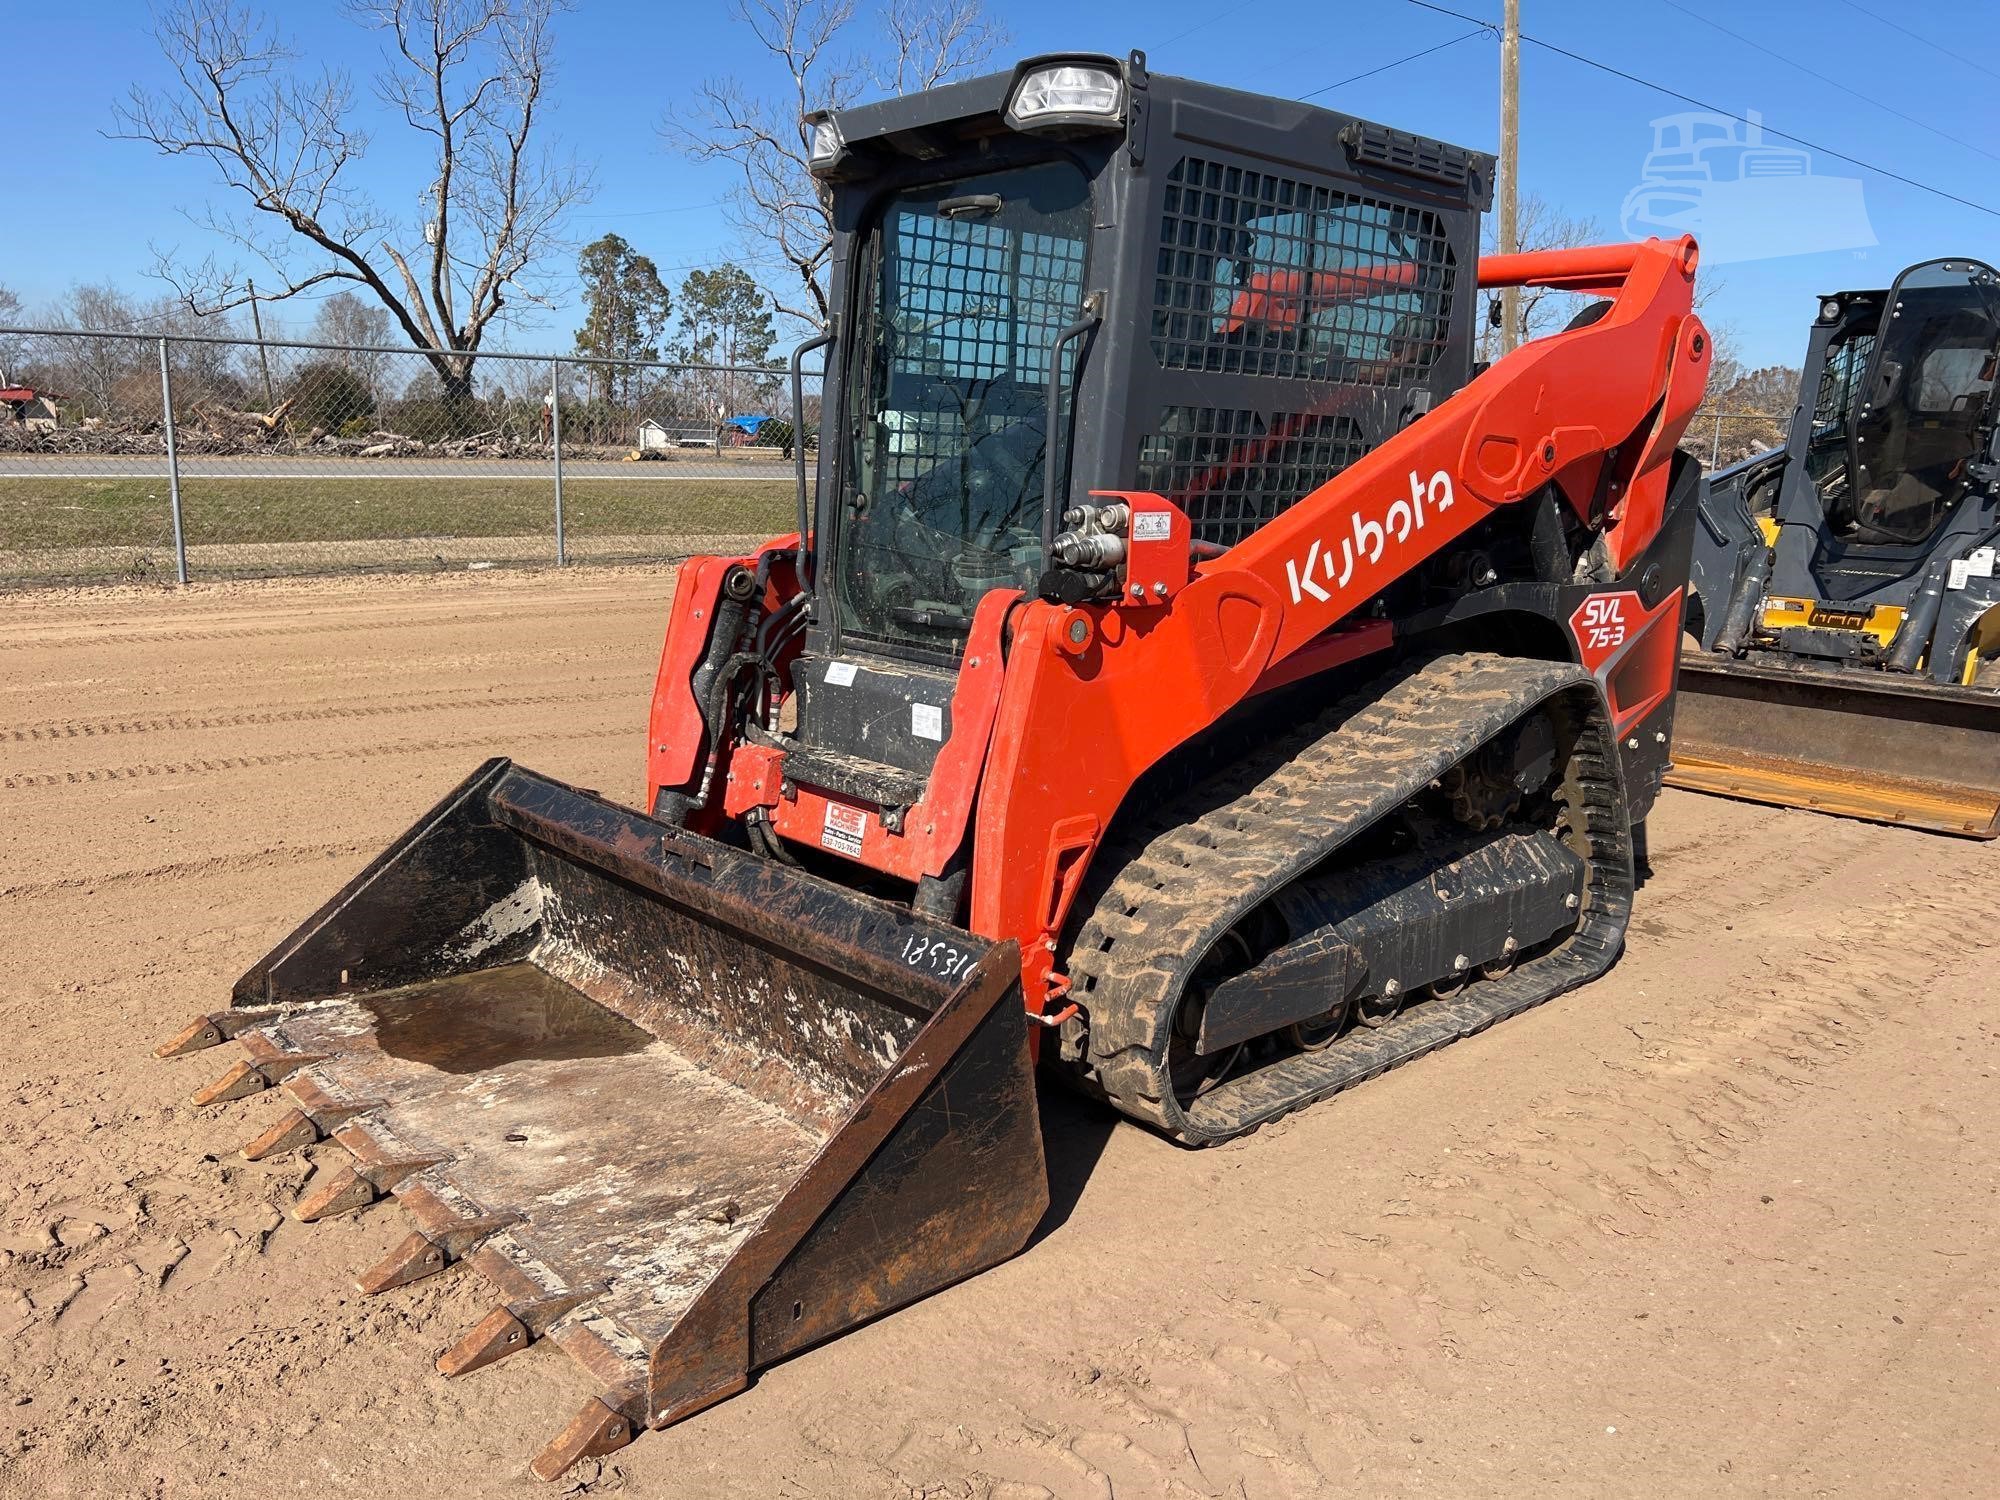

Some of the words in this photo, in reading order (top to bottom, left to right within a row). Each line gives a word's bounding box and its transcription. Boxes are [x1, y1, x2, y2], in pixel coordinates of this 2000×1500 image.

[1285, 470, 1454, 605] Kubota
[1581, 599, 1625, 627] SVL
[1587, 626, 1626, 649] 75-3
